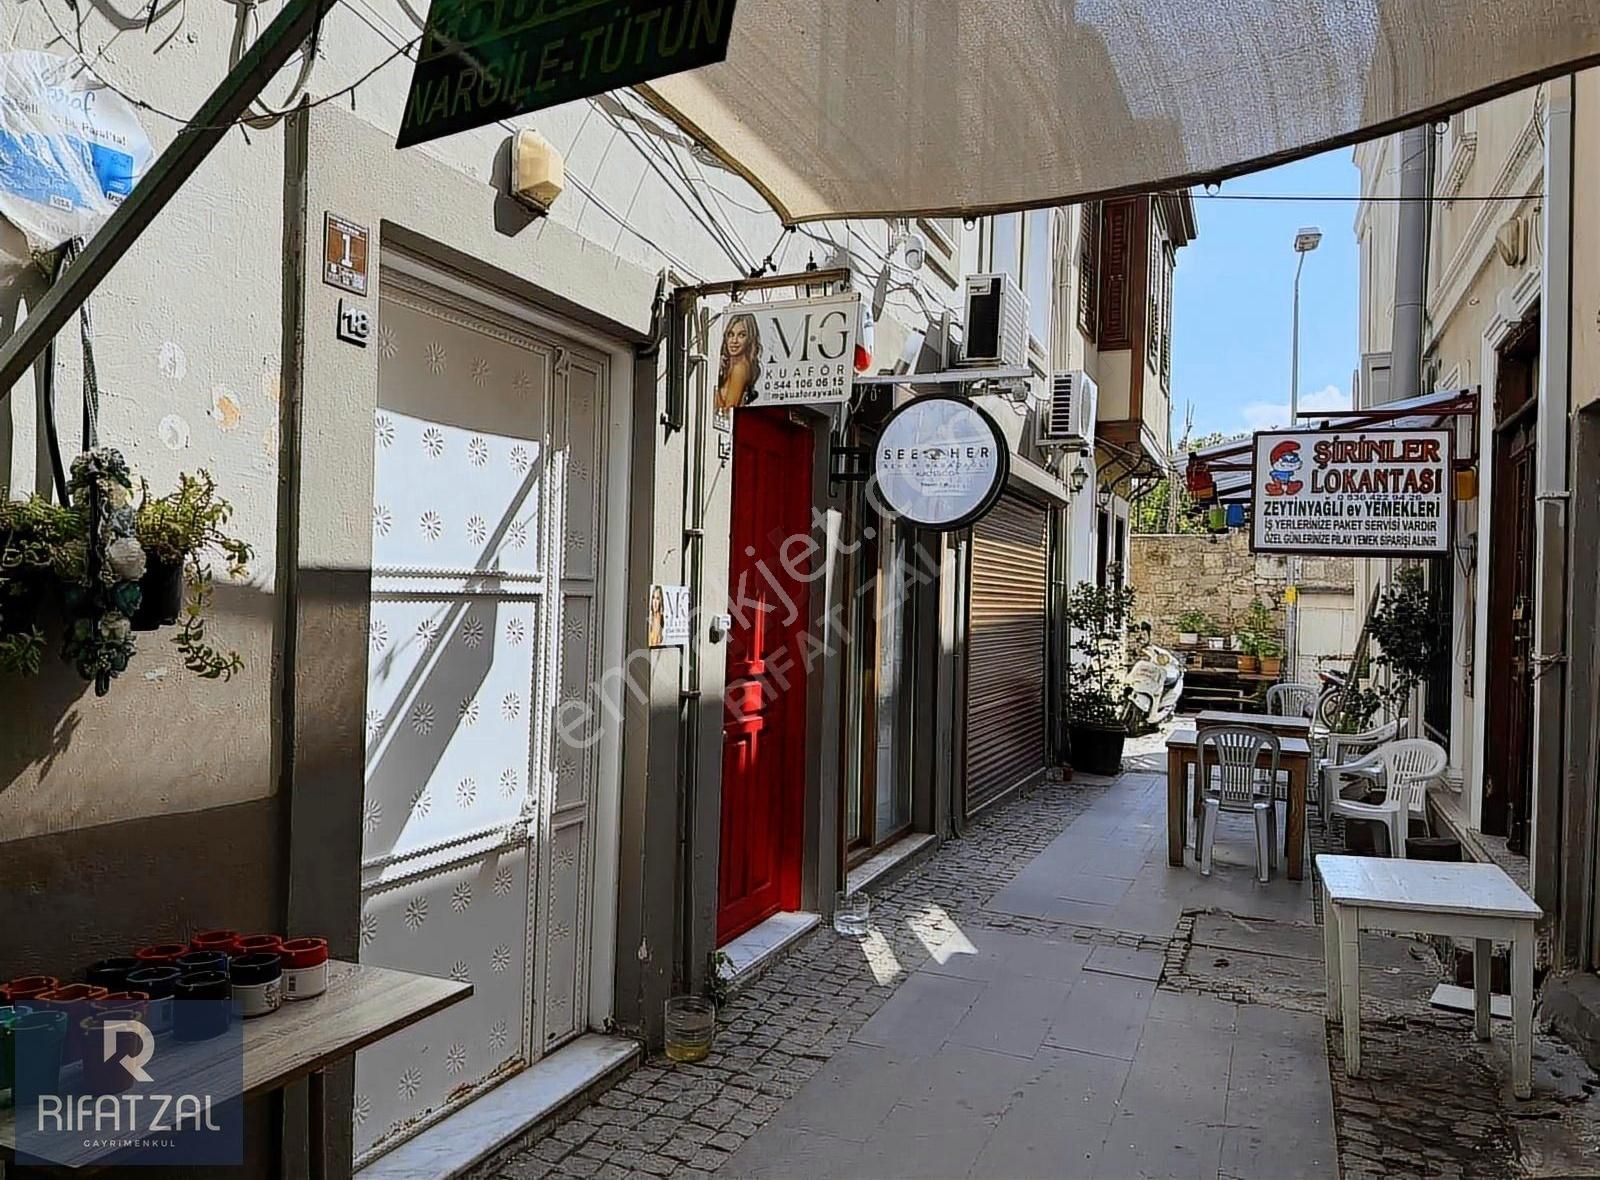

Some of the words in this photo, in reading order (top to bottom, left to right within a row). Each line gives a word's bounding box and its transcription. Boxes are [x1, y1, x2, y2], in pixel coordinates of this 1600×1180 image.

[774, 380, 791, 390] 544
[796, 379, 813, 388] 106
[815, 378, 828, 387] 06
[833, 377, 844, 386] 15
[884, 448, 918, 460] SEE
[950, 447, 989, 459] HER
[1313, 435, 1441, 469] ŞİRİNLER
[1311, 468, 1442, 494] LOKANTASI
[1347, 504, 1361, 517] ev
[1365, 496, 1440, 517] YEMEKLERİ
[1275, 518, 1331, 530] YERLERİNİZE
[1333, 520, 1362, 531] PAKET
[1364, 519, 1400, 532] SERVİSİ
[1402, 520, 1437, 532] VARDIR
[1353, 534, 1379, 546] YEMEK
[1411, 535, 1437, 547] ALINIR
